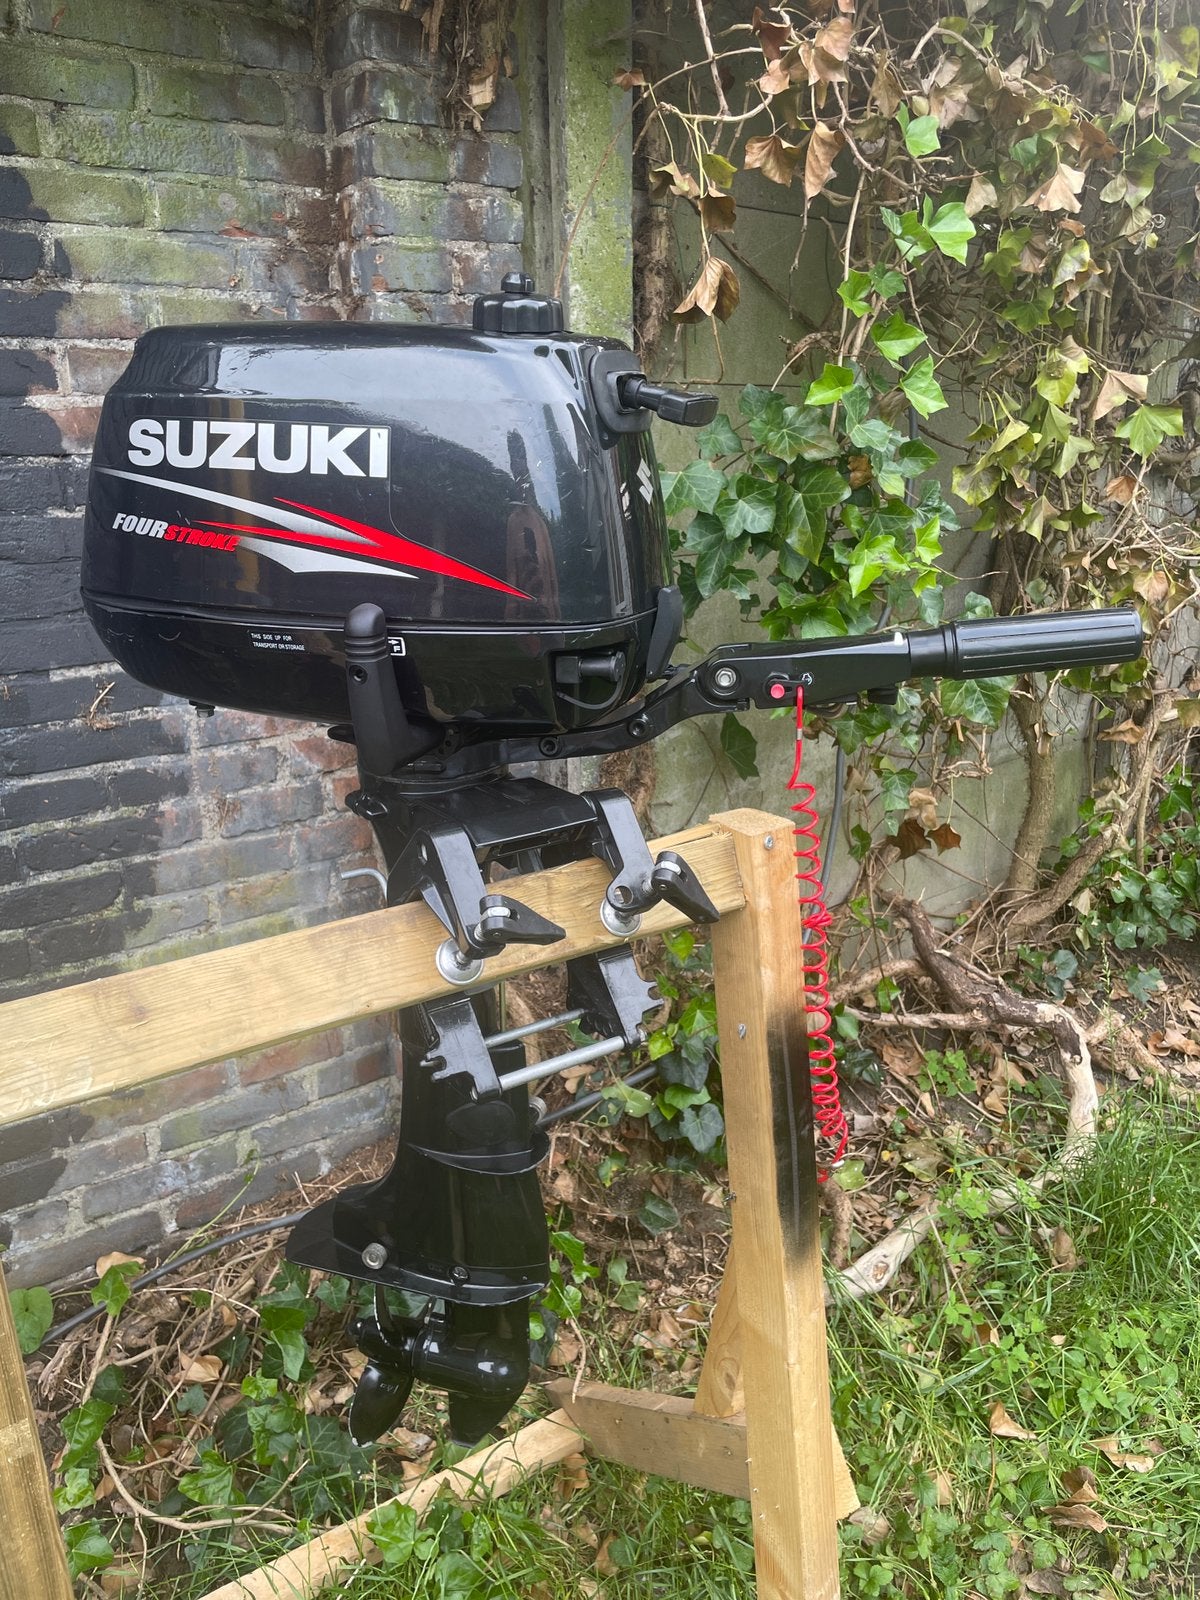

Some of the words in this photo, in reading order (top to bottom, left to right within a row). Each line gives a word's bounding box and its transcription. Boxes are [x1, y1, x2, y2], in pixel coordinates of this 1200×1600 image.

[127, 419, 389, 478] SUZUKI
[262, 633, 273, 641] SIDE
[252, 641, 277, 649] TRANSPORT
[393, 645, 401, 653] F
